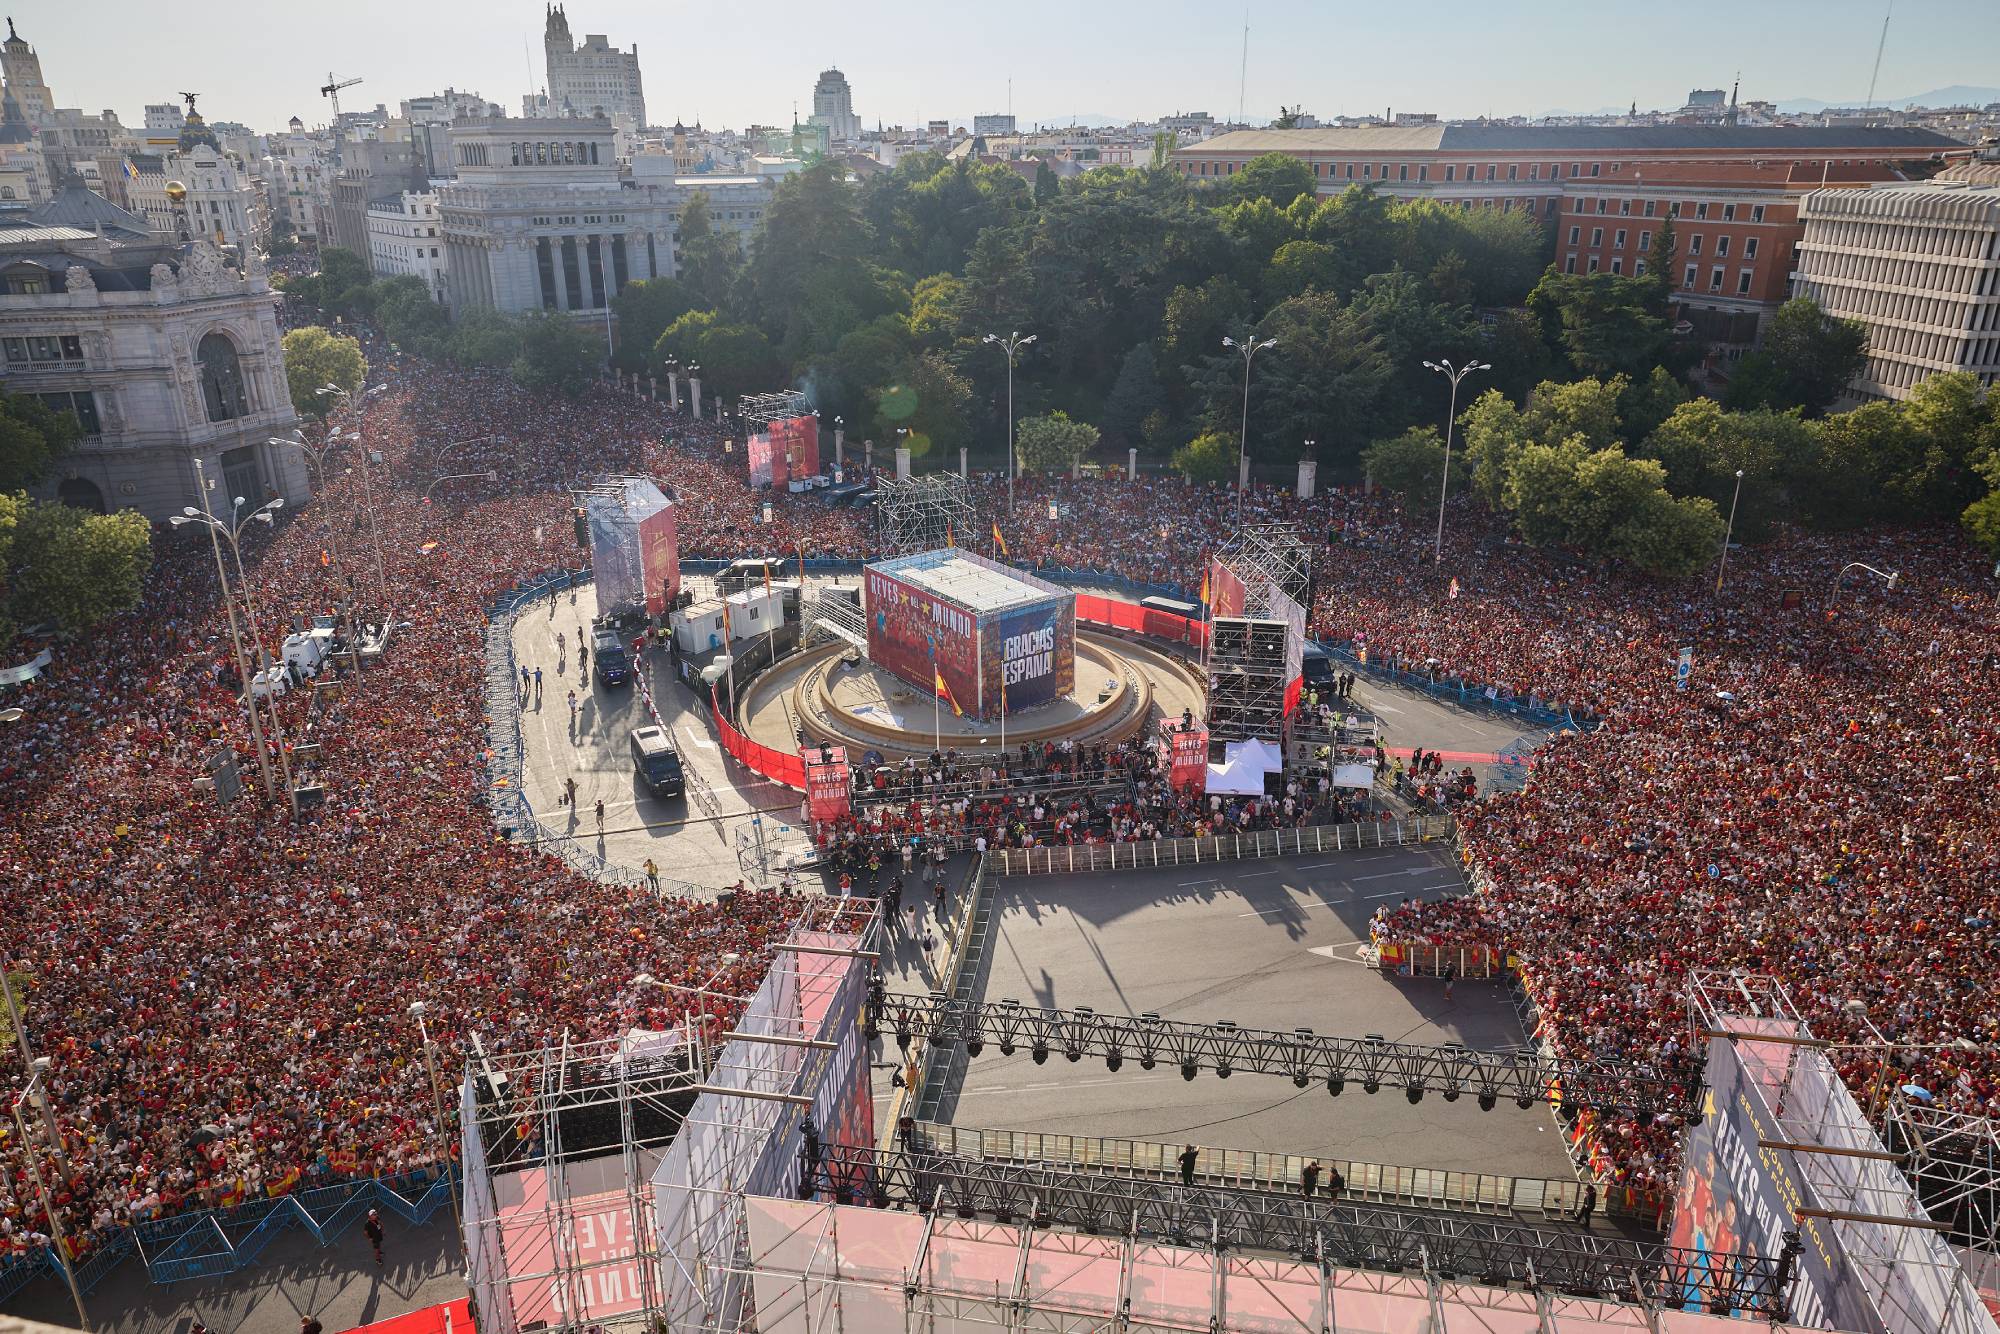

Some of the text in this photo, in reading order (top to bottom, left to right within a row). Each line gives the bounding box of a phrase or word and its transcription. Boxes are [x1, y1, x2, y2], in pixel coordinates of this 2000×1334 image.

[870, 575, 971, 639] REYES DEL MUNDO
[1180, 740, 1201, 750] REYES
[1176, 755, 1203, 766] MUNDO
[816, 772, 841, 783] REYES
[814, 787, 846, 800] MUNDO
[818, 1017, 856, 1134] MUNDO
[1758, 1147, 1770, 1170] DE
[1714, 1107, 1760, 1216] REYES
[1755, 1194, 1771, 1236] DEL
[1740, 1094, 1832, 1270] SELECIÓN ESPÑOLA
